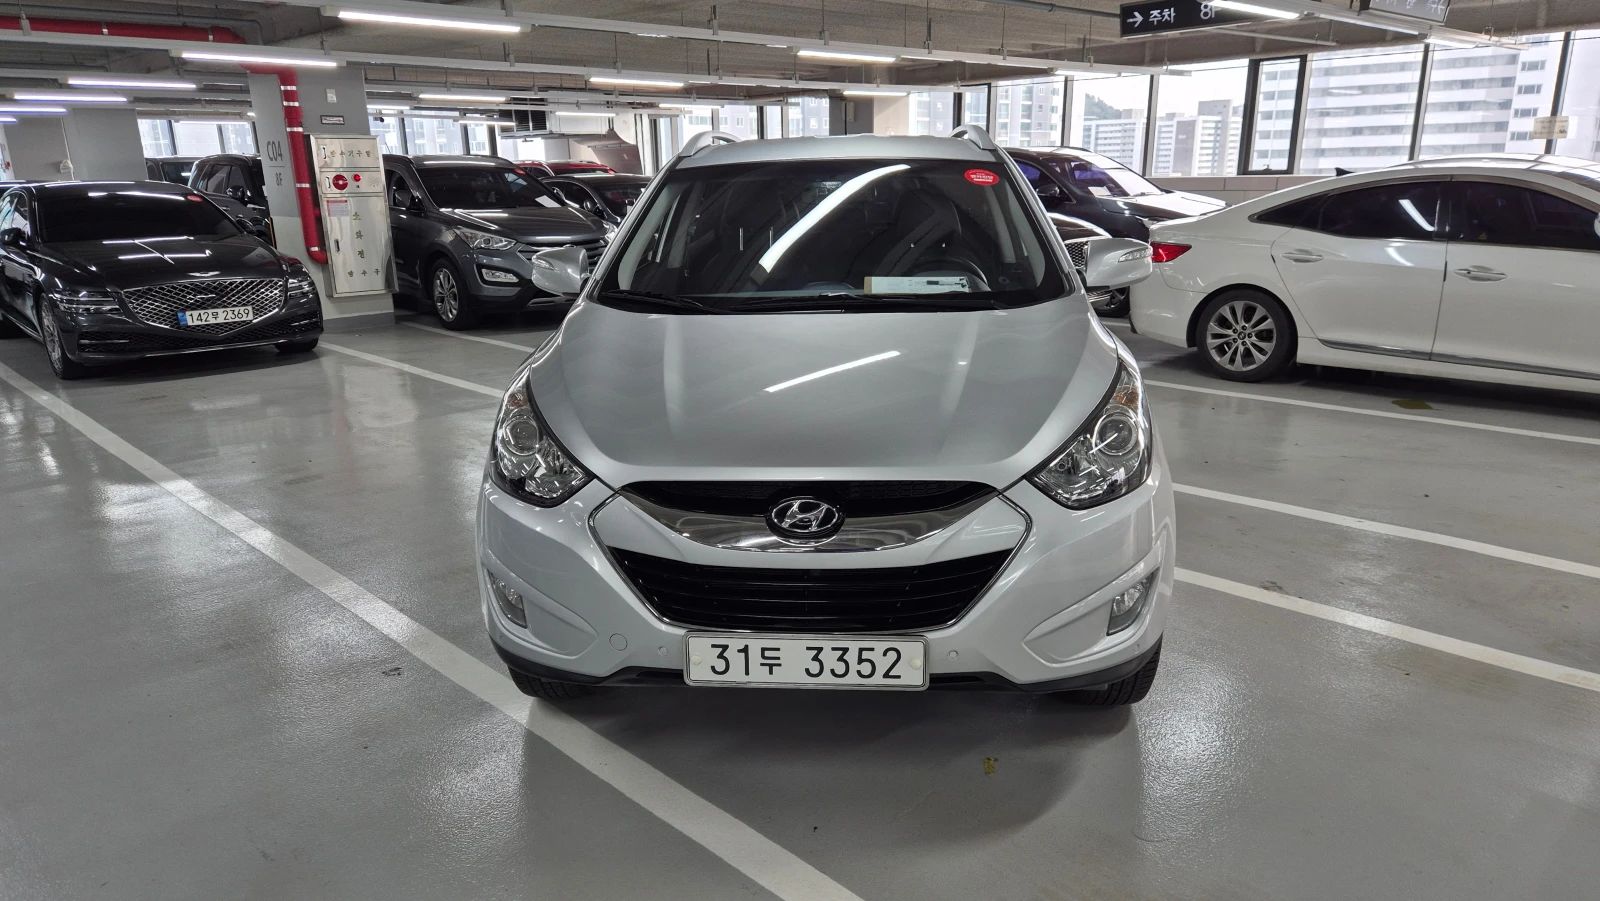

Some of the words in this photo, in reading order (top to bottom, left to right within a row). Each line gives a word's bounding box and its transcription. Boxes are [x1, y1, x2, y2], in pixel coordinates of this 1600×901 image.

[1149, 7, 1176, 25] 주차
[266, 140, 284, 162] C04
[275, 172, 283, 187] 8F
[188, 311, 220, 324] 142무
[222, 307, 250, 321] 2369
[710, 643, 782, 676] 31두
[804, 646, 902, 680] 3352
